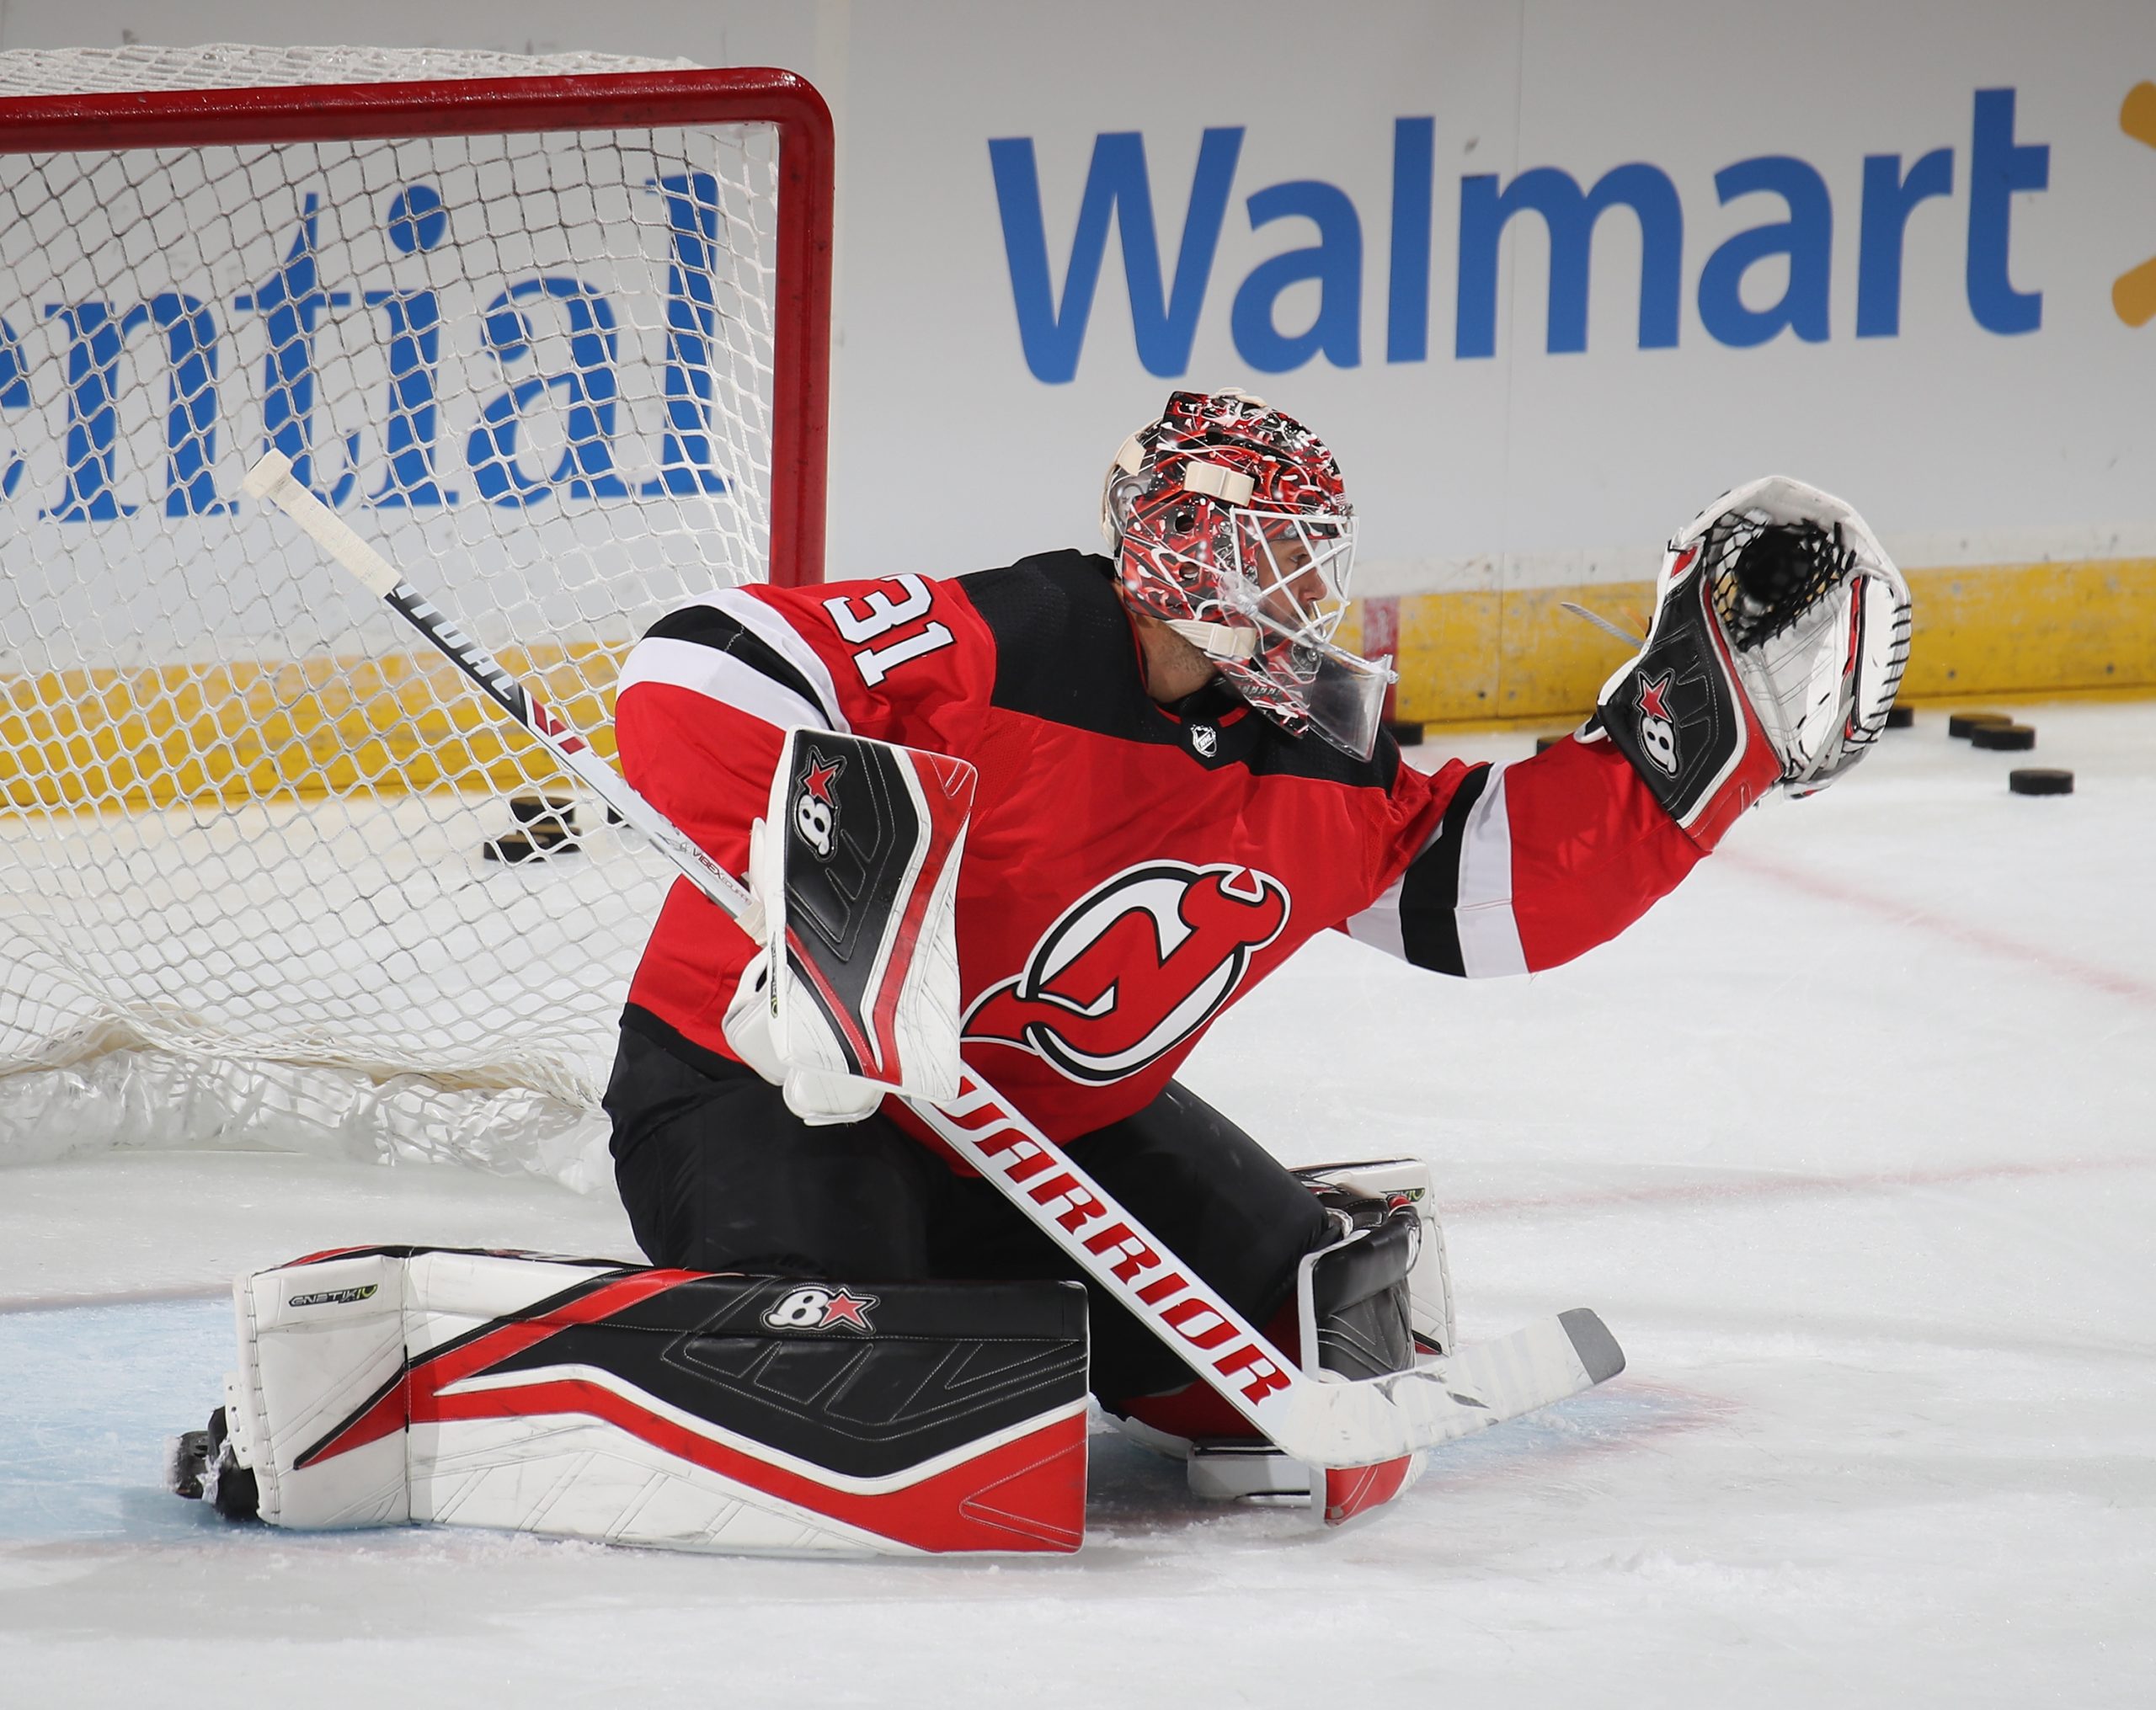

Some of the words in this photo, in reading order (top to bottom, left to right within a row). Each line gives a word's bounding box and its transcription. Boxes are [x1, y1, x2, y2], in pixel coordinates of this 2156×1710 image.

[0, 173, 735, 523] ntial
[988, 88, 2050, 385] Walmart
[821, 573, 958, 690] 31
